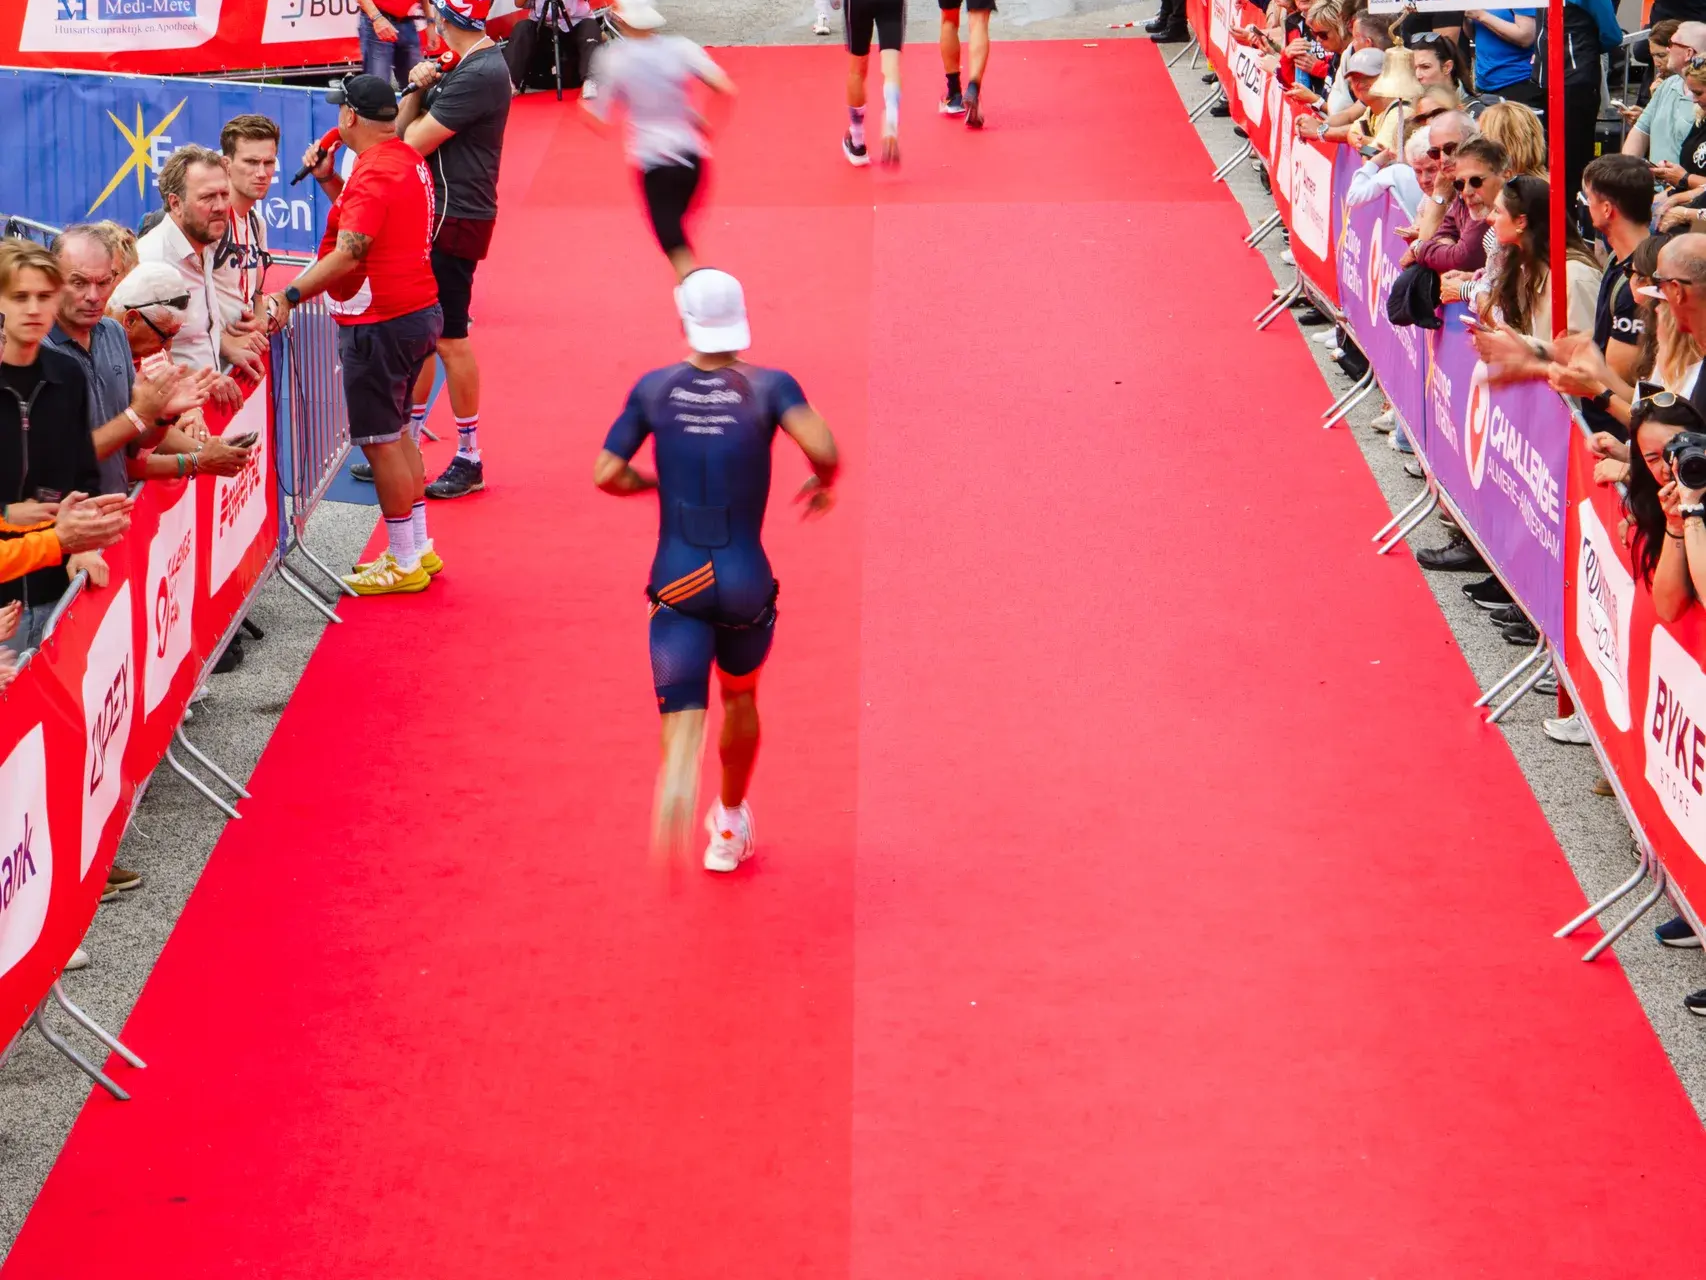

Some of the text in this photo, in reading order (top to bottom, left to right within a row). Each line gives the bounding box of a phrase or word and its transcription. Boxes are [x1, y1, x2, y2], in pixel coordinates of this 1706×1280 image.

[54, 25, 142, 36] Huisartsenpraktijk
[157, 22, 198, 33] Apotheek
[1487, 455, 1560, 563] ALMERE-AMSTERDAM
[1490, 404, 1559, 525] CHALLENGE
[1653, 675, 1706, 797] BYKE
[1659, 765, 1690, 818] STORE
[0, 812, 36, 914] ank
